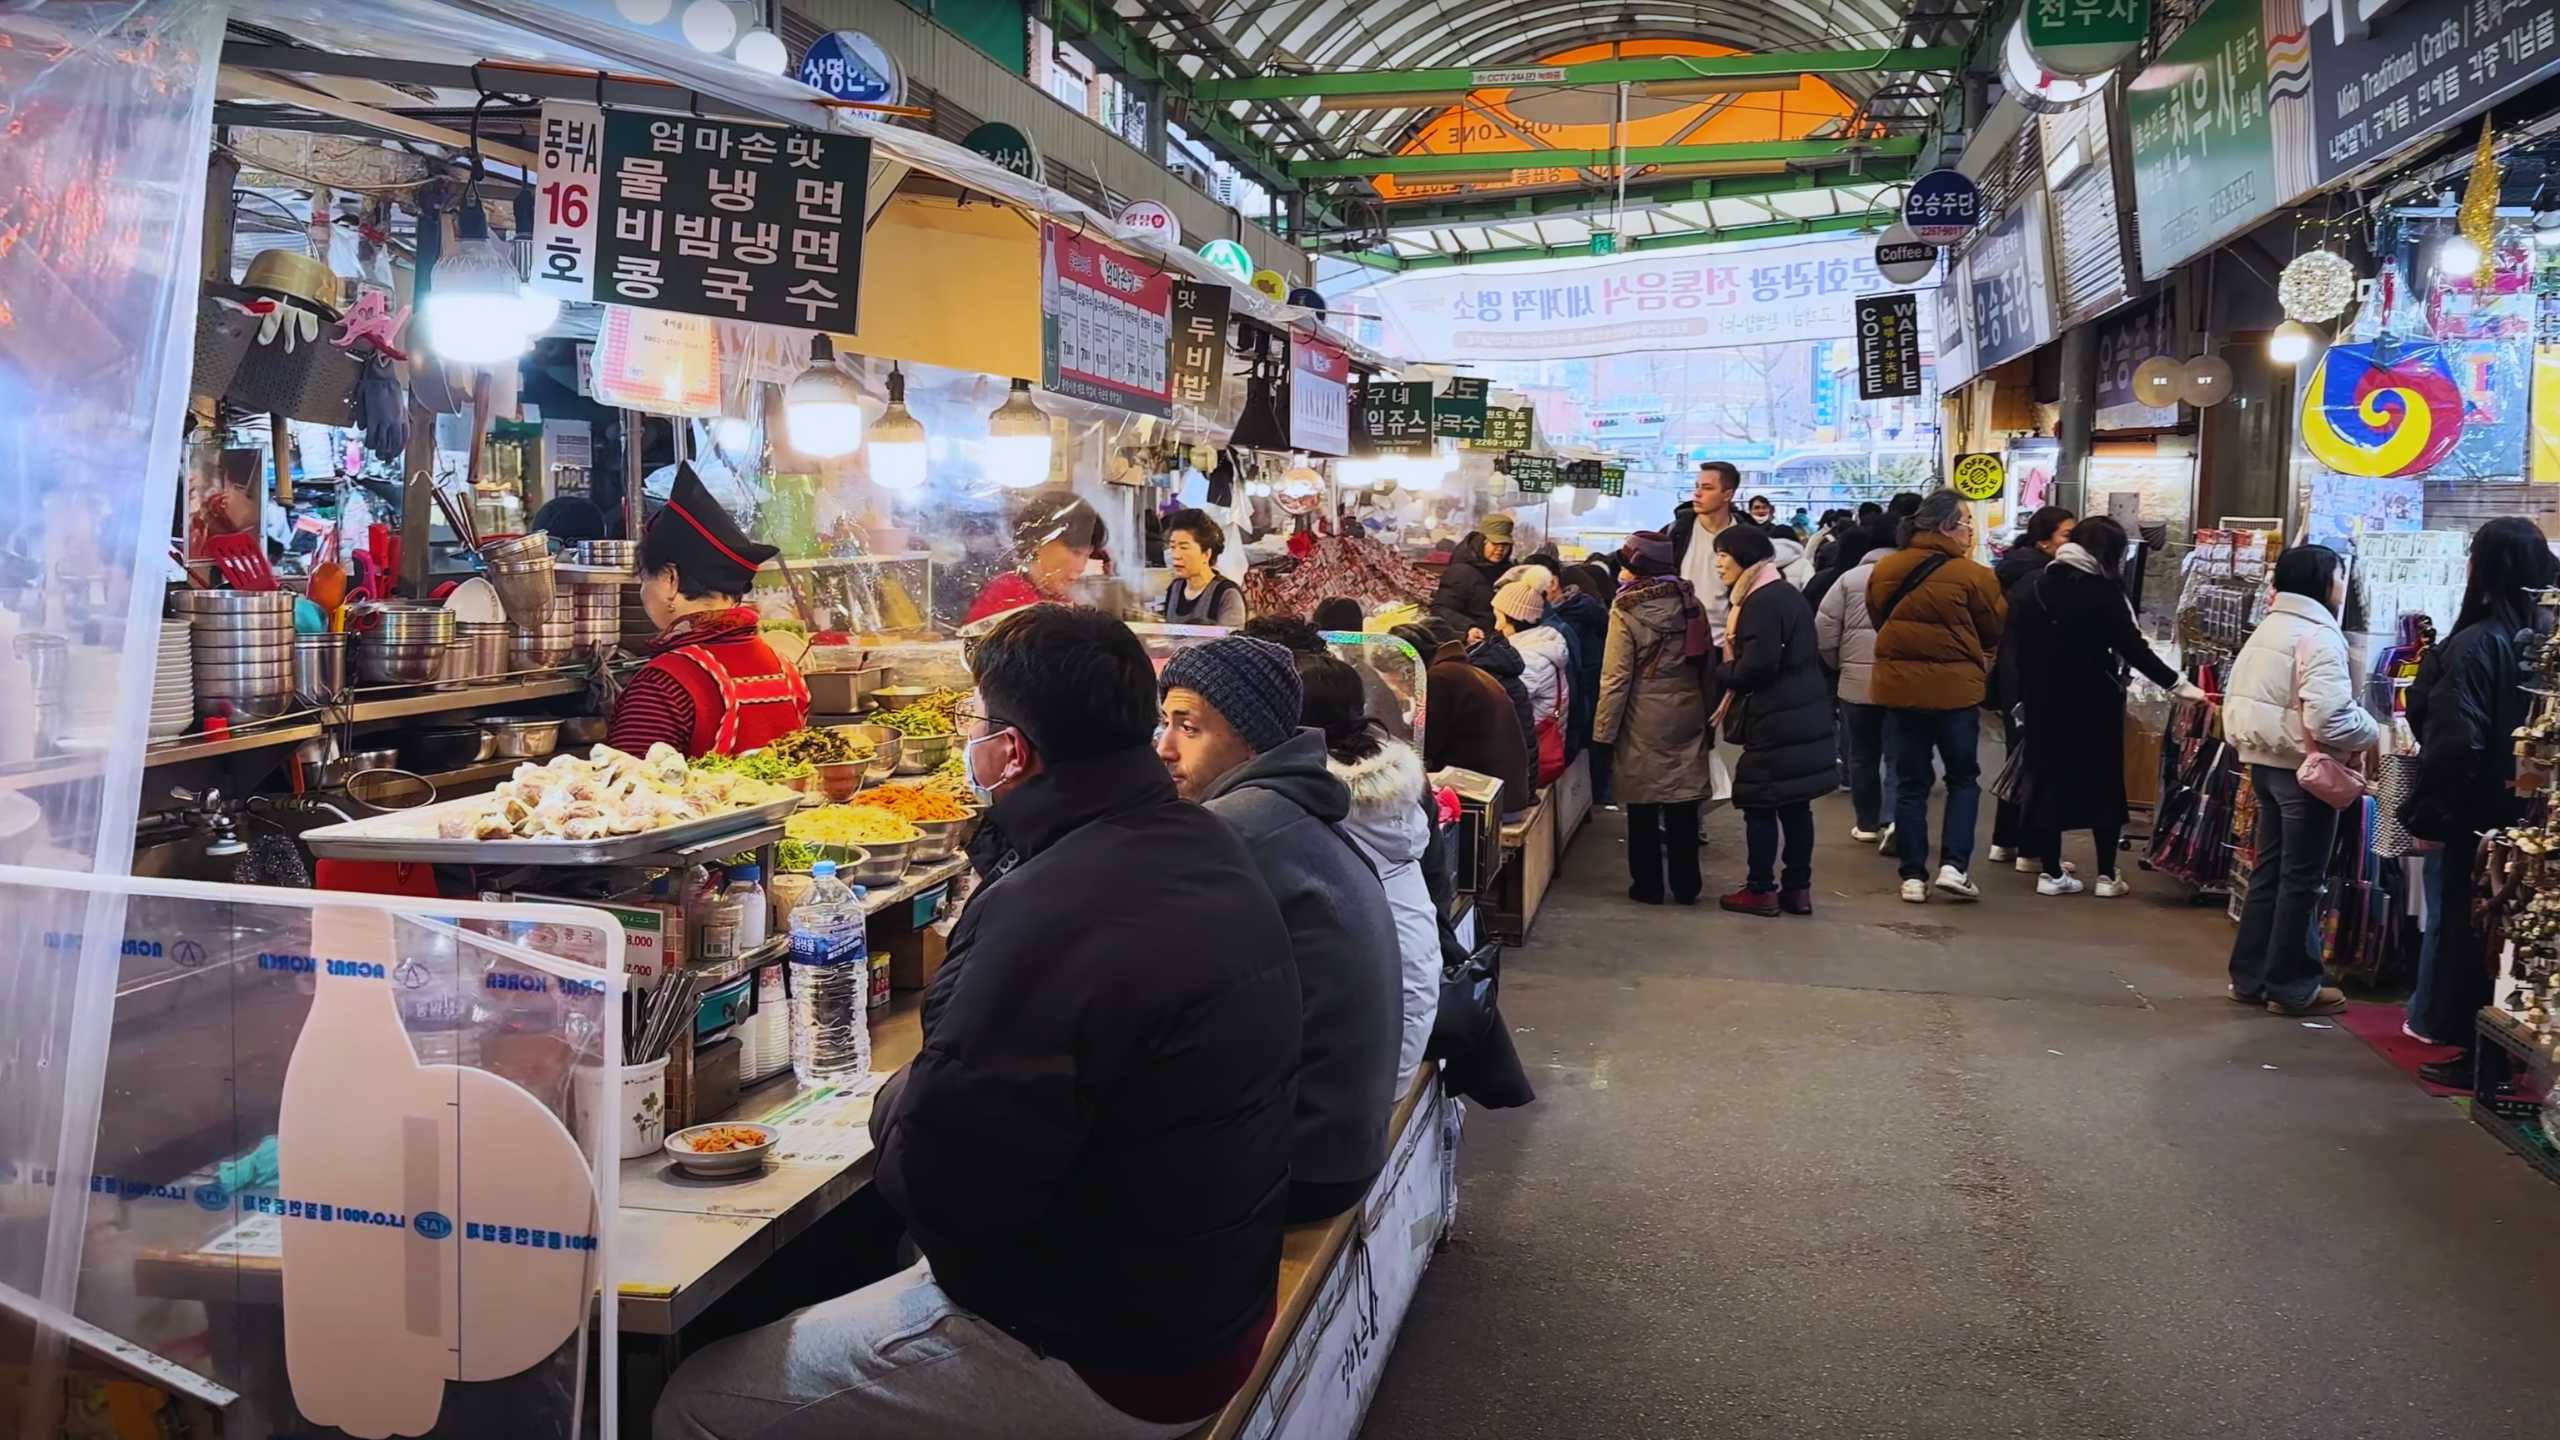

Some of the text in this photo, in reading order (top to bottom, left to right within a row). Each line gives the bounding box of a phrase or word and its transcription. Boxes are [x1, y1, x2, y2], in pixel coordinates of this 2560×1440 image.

[2362, 42, 2418, 103] Traditional
[2421, 18, 2460, 66] Crafts
[2373, 94, 2417, 139] 공예품,
[2417, 65, 2460, 117] 민예품
[2468, 41, 2500, 84] 각종
[2501, 9, 2555, 64] 기념품
[544, 119, 597, 174] 동부A
[542, 181, 588, 228] 16
[1908, 192, 1974, 217] 오승주단
[541, 236, 583, 284] 호
[615, 206, 840, 274] 비빔냉면
[1881, 246, 1922, 262] Coffee
[1977, 256, 2031, 350] 오승주단
[1861, 307, 1884, 394] COFFEE
[1893, 303, 1918, 390] WAFFLE
